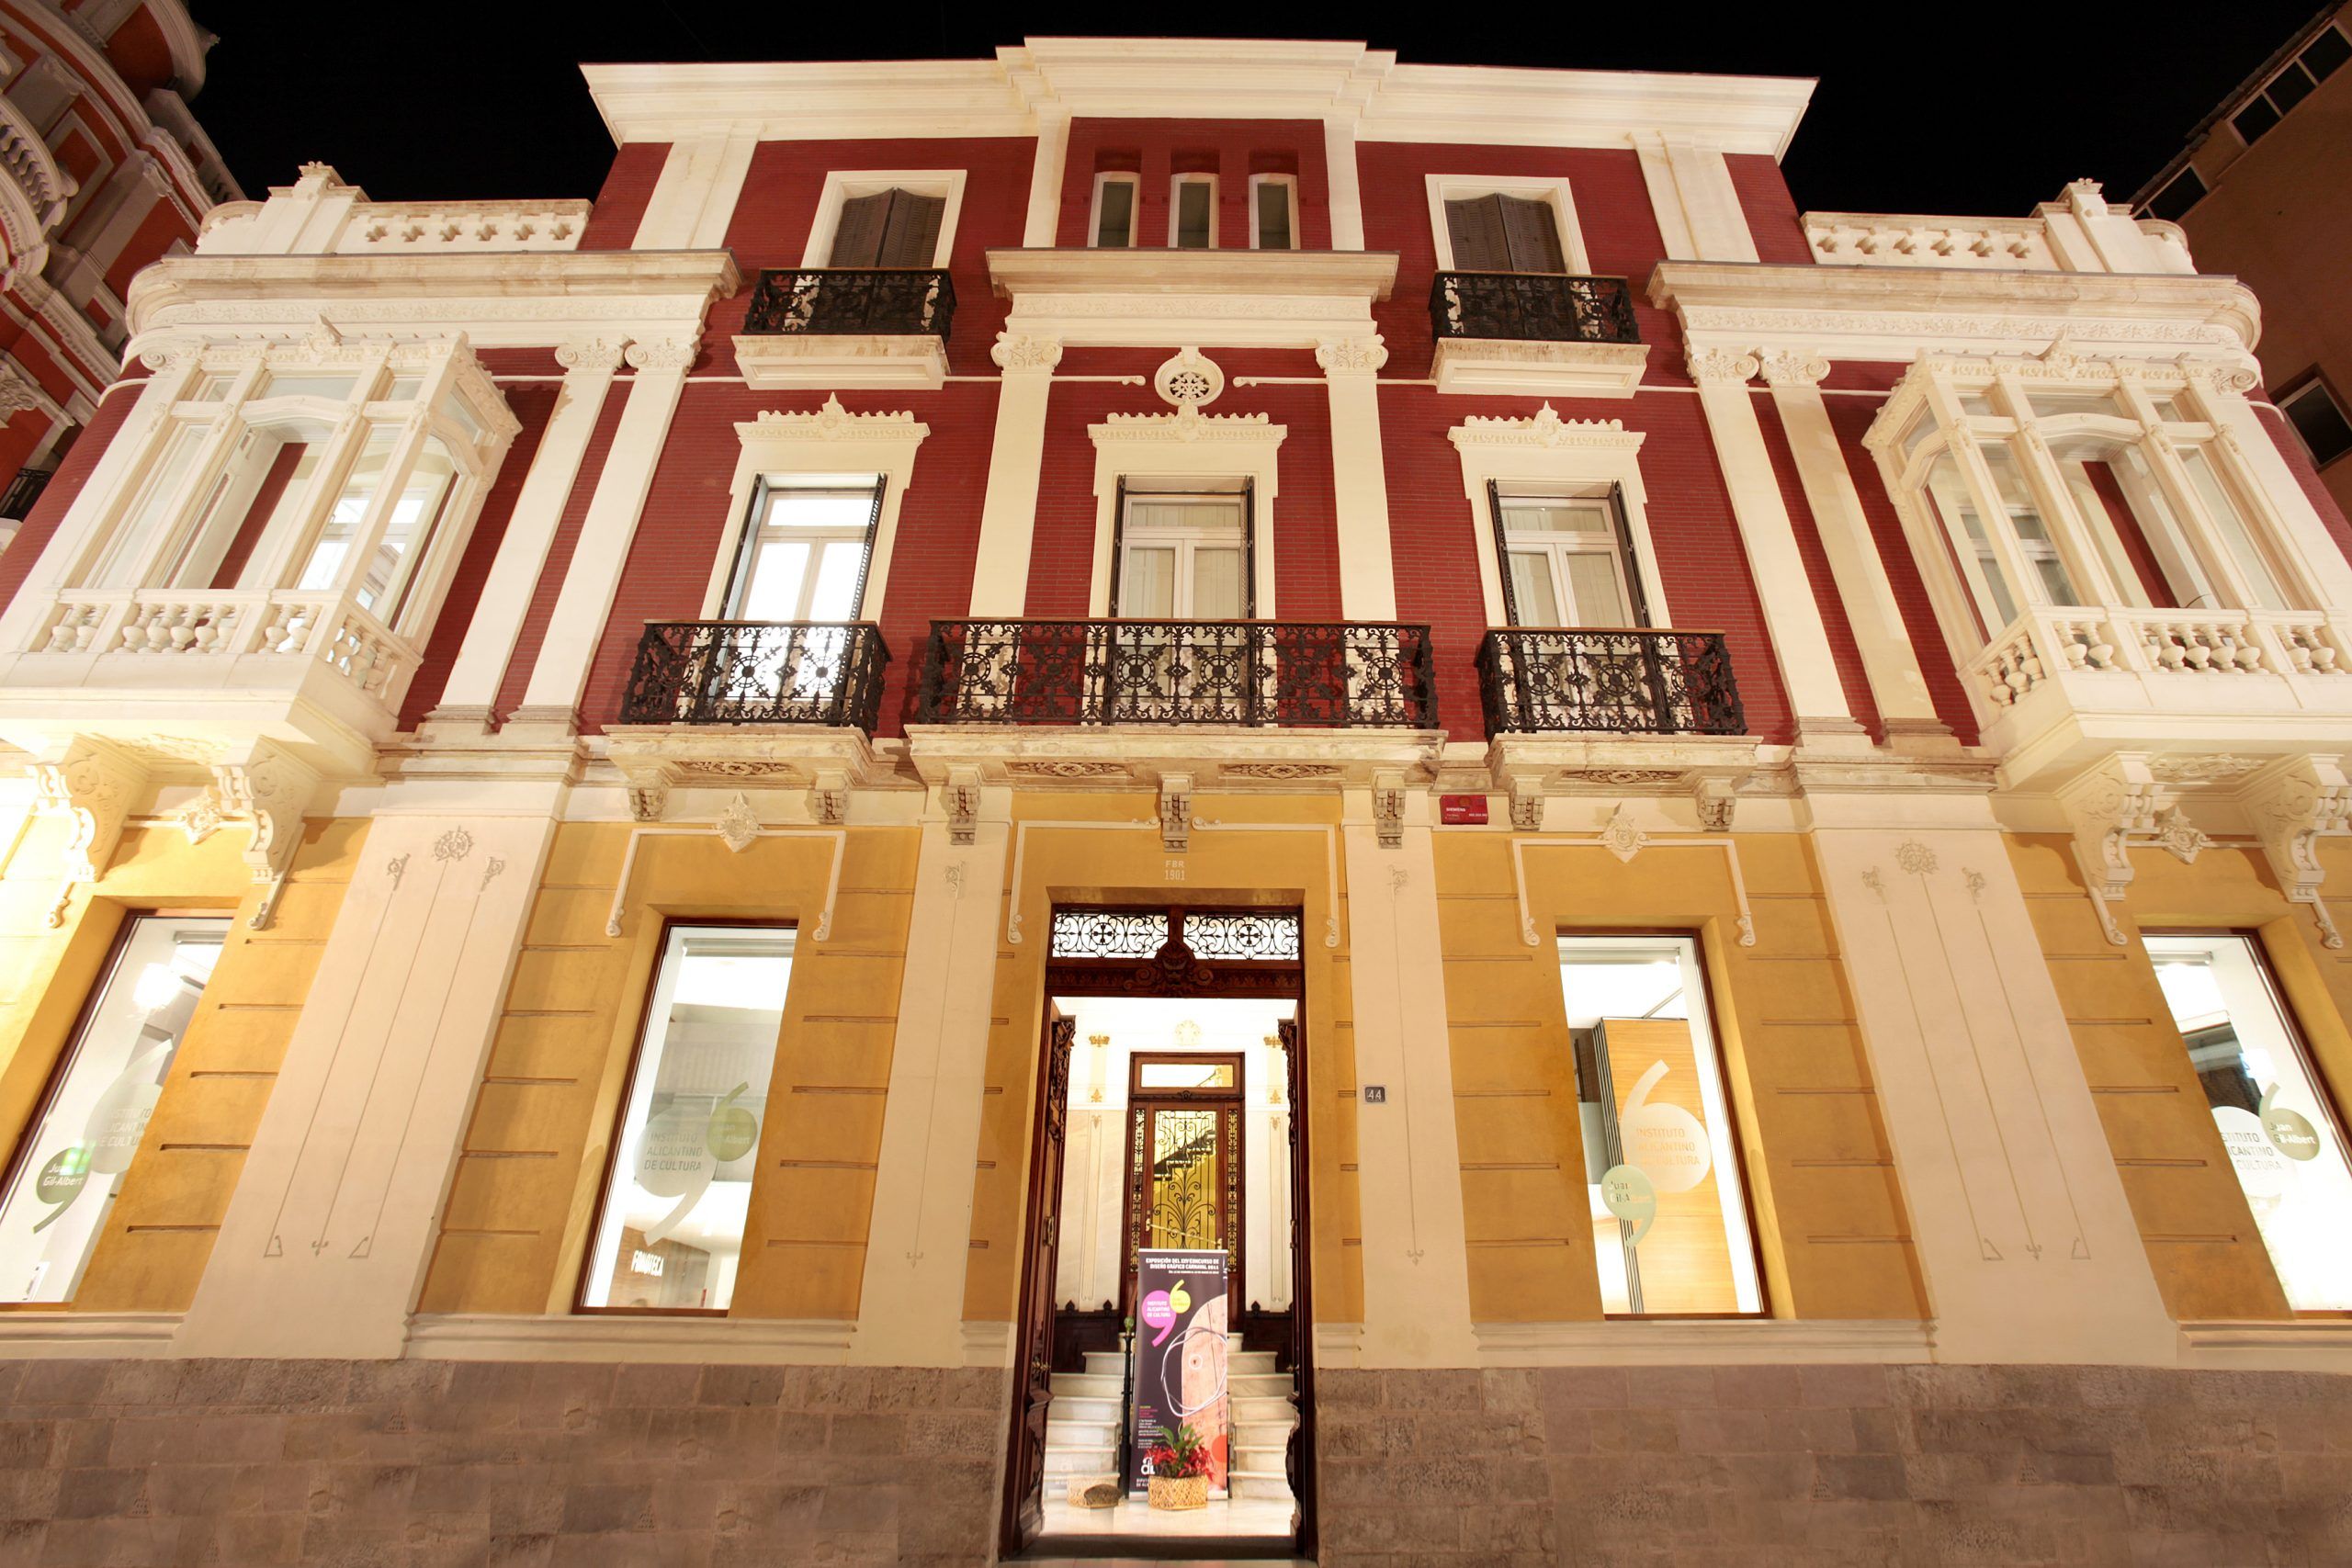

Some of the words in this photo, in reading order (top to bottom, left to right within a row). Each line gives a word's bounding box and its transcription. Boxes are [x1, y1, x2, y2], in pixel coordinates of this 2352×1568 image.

[1165, 860, 1185, 868] FBR
[1164, 870, 1186, 881] 1901
[1367, 1089, 1382, 1100] 44
[649, 1132, 698, 1143] INSTITUTO
[1635, 1127, 1686, 1138] INSTITUTO
[646, 1145, 704, 1157] ALICANTINO
[1638, 1141, 1697, 1152] ALICANTINO
[643, 1159, 658, 1170] DE
[659, 1160, 702, 1171] CULTURA
[2235, 1158, 2284, 1170] CULTURA
[42, 1176, 85, 1187] Gil-Albert
